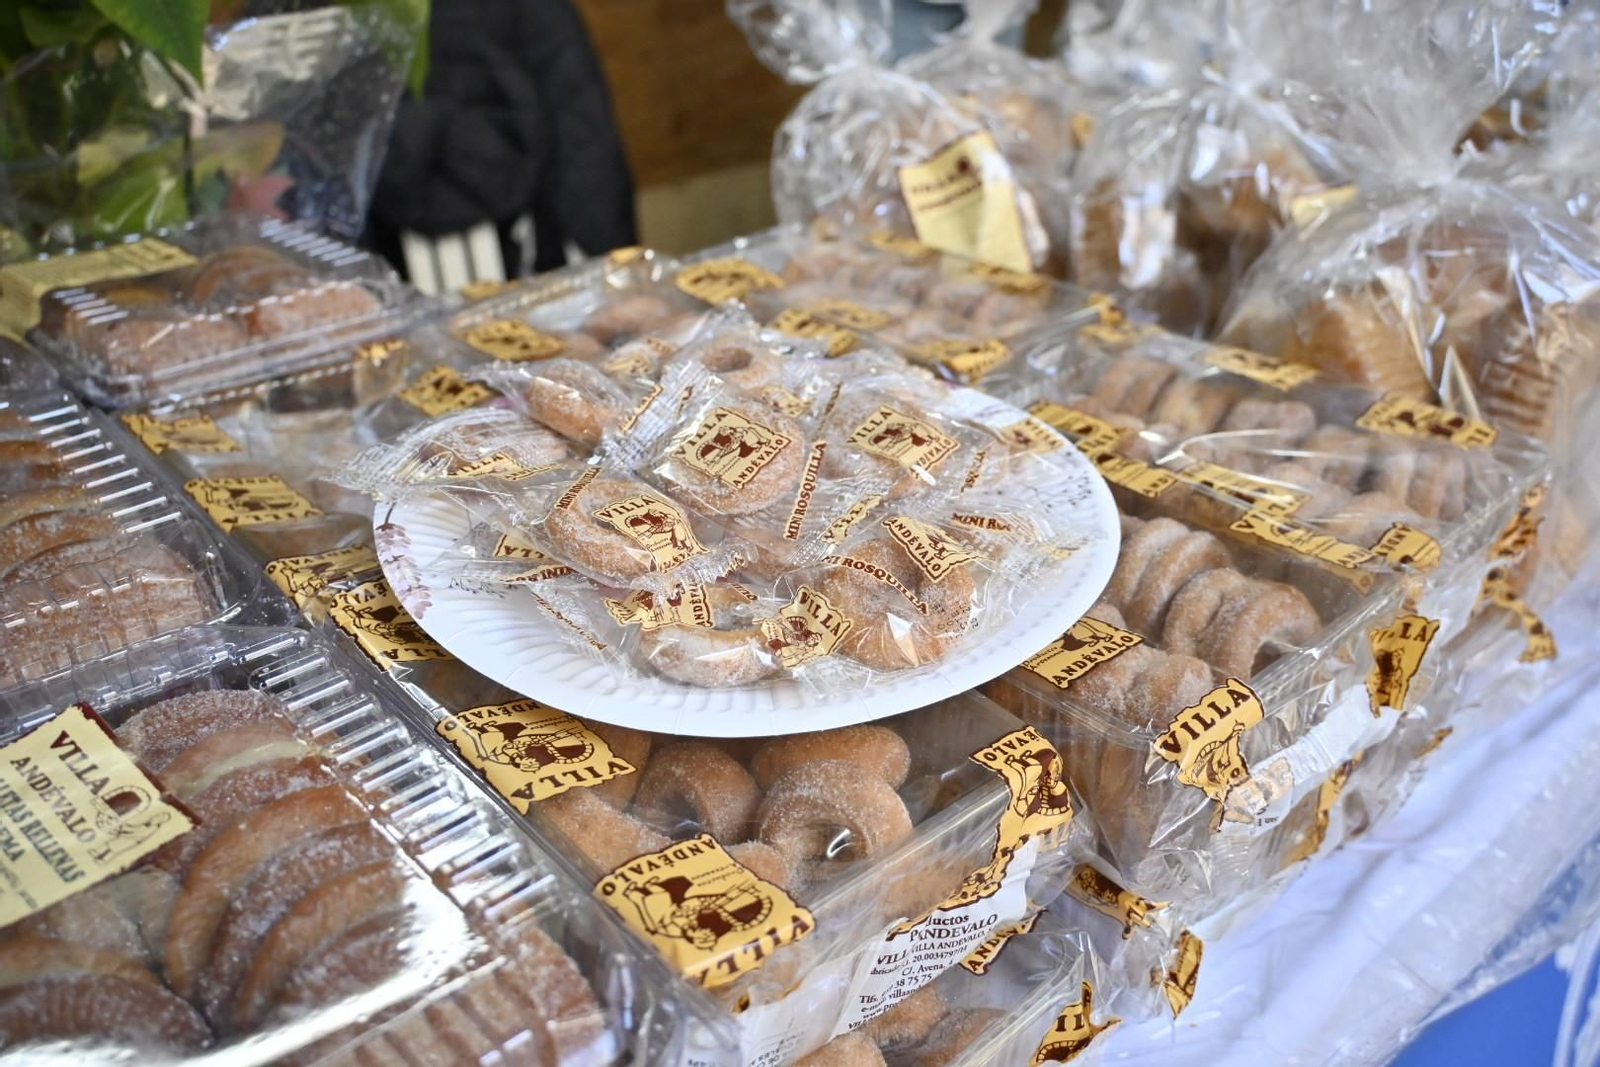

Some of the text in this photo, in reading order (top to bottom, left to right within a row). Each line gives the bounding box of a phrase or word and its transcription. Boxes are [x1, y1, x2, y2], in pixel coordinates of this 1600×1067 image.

[675, 412, 729, 457] VILLA
[847, 410, 893, 444] VILLA
[732, 438, 784, 487] ANDÉVALO
[796, 441, 827, 517] ROSQUILLA
[600, 498, 654, 519] VILLA
[889, 518, 942, 573] ANDÉVALO
[841, 557, 928, 615] ROSQUILLA
[799, 591, 843, 637] VILLA
[1052, 635, 1134, 685] ANDÉVALO
[444, 701, 541, 731] NDÉVALO
[1160, 688, 1250, 753] VILLA
[50, 730, 111, 796] VILLA
[511, 761, 630, 800] VILLA
[10, 756, 96, 843] ANDÉVALO
[20, 819, 86, 883] RELLENAS
[602, 839, 717, 897] ANDÉVALO
[908, 975, 919, 987] 75
[921, 973, 932, 985] 75
